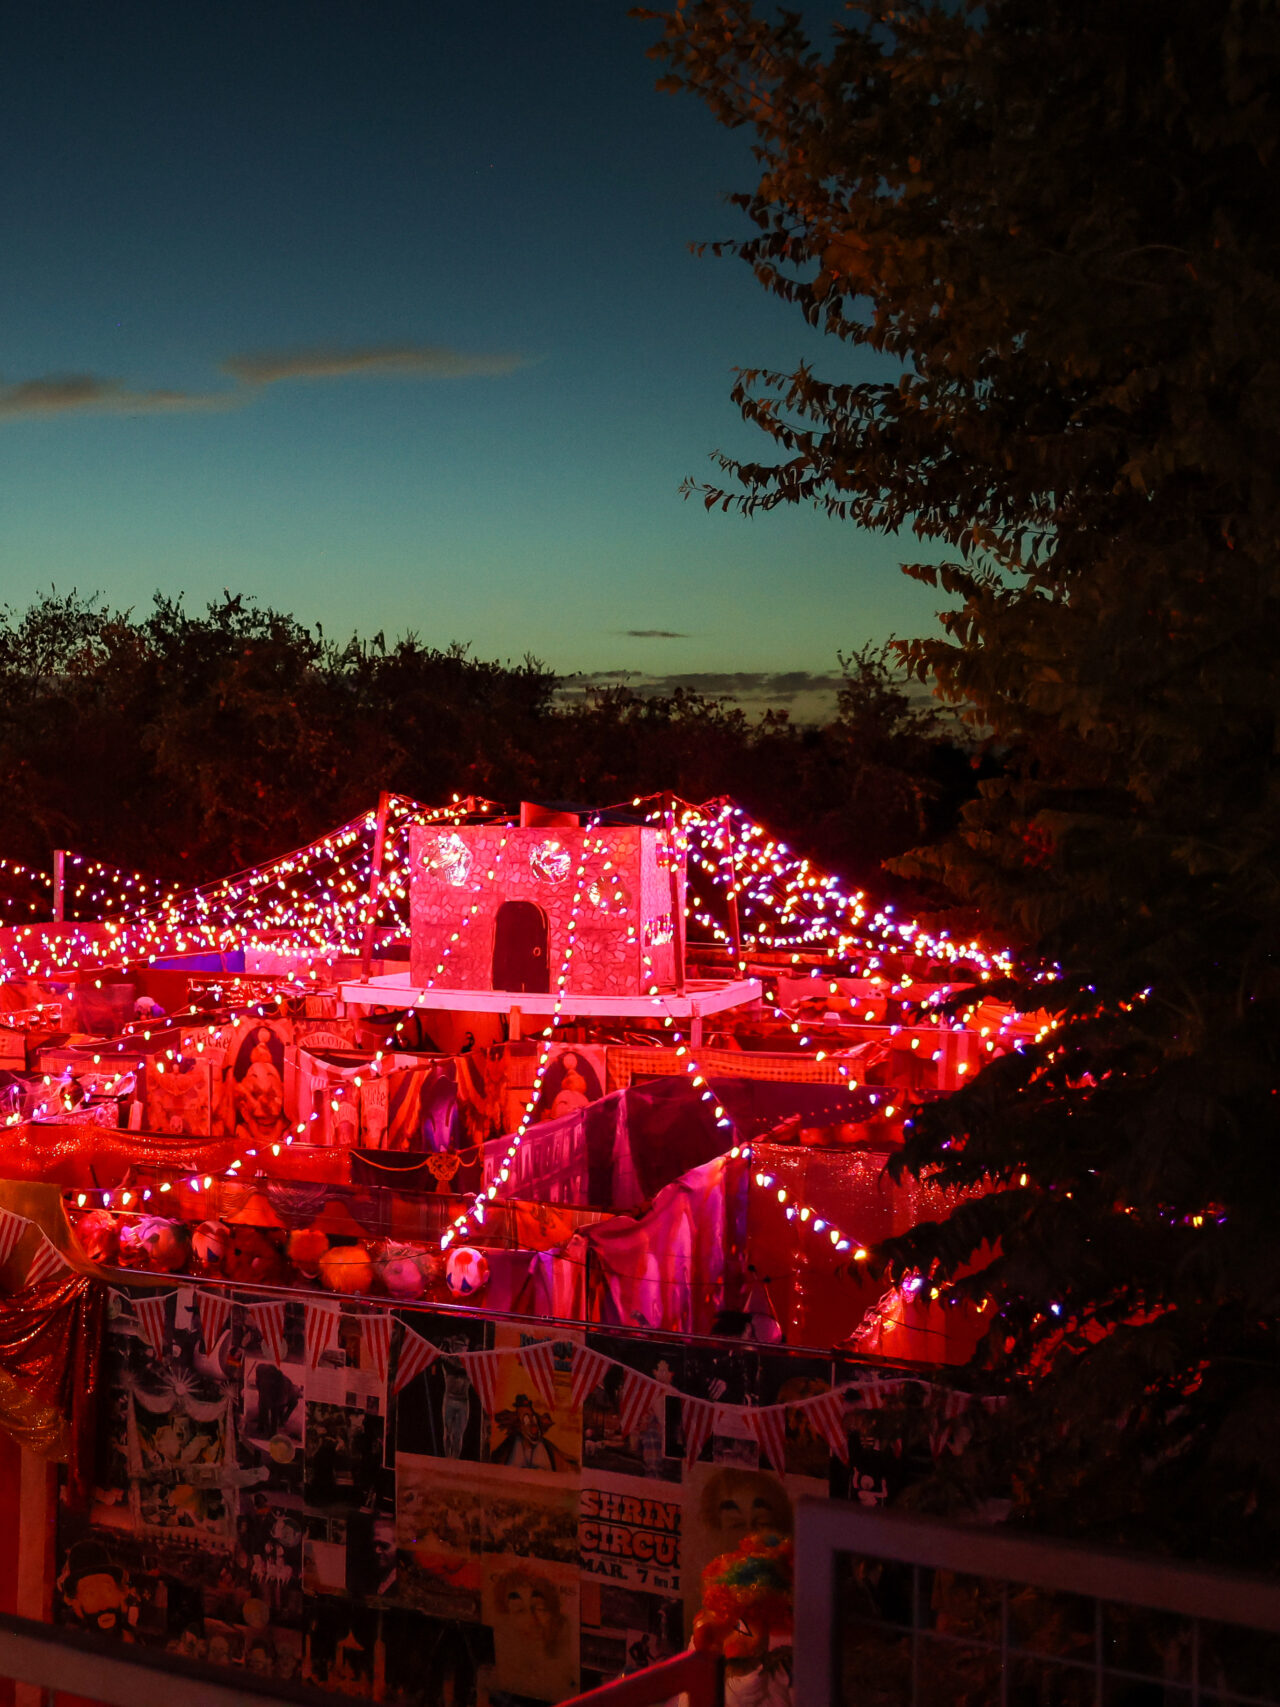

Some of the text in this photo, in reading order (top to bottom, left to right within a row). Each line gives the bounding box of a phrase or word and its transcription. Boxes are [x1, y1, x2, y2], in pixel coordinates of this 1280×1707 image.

[580, 1488, 681, 1536] SHRIN
[578, 1521, 681, 1569] CIRCU
[578, 1558, 628, 1579] MAR.
[636, 1568, 649, 1584] 7
